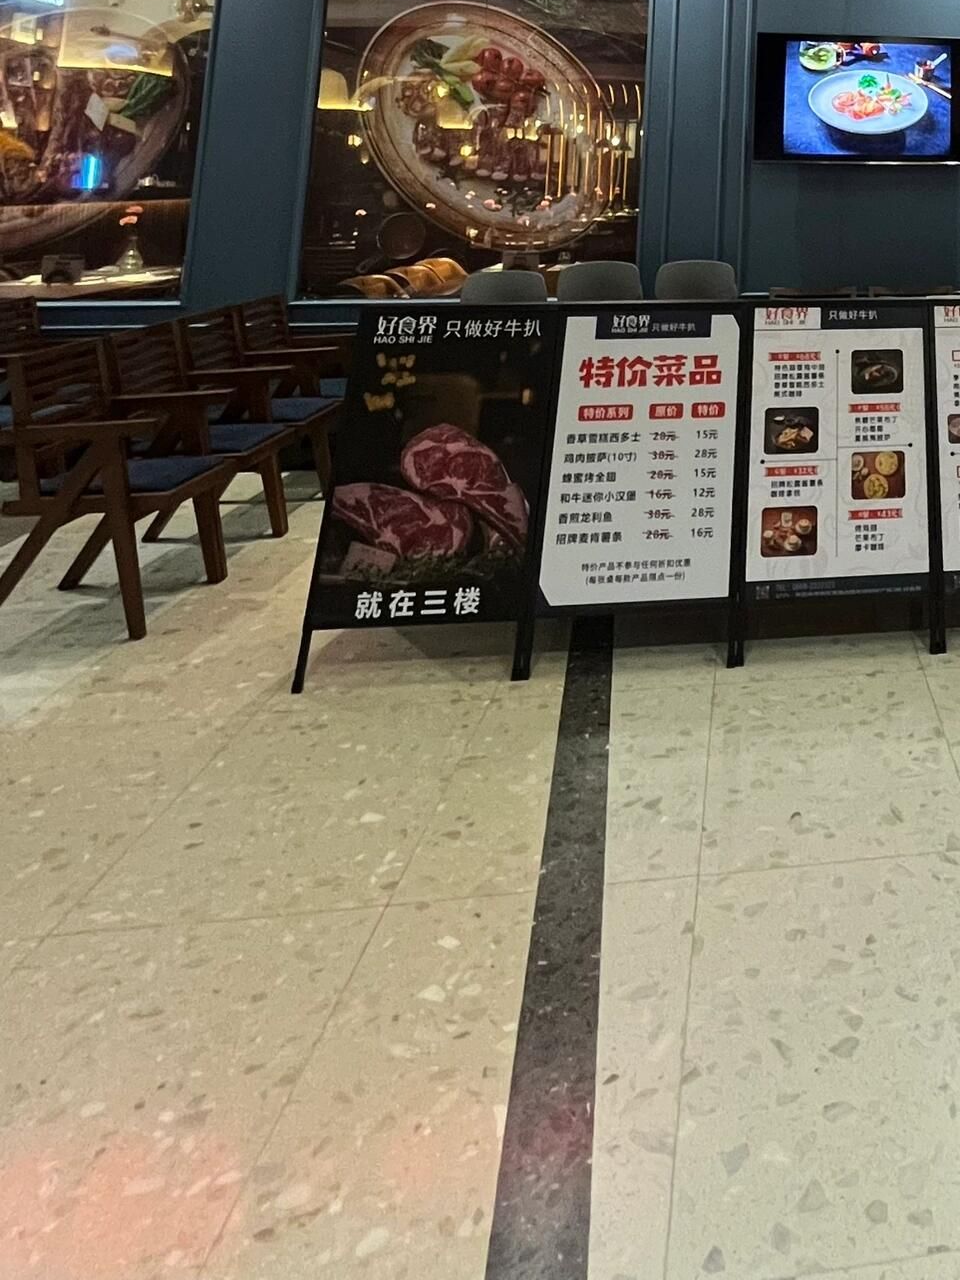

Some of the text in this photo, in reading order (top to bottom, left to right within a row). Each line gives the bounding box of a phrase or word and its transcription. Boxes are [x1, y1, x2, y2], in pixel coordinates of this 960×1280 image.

[612, 314, 650, 328] 好食界
[828, 310, 878, 320] 只做好牛扒
[376, 315, 438, 335] 好食界
[443, 319, 541, 338] 只做好牛扒
[651, 322, 697, 332] 只做好牛扒
[373, 335, 433, 344] HAO SHI JIE
[578, 354, 722, 388] 特价菜品
[583, 404, 720, 420] 特价系列 原价 特价
[696, 429, 719, 439] 15元
[694, 448, 718, 459] 28元
[694, 468, 717, 478] 15元
[560, 490, 636, 504] 和牛迷你小汉堡
[693, 487, 716, 498] 12元
[558, 511, 613, 524] 香煎龙利鱼
[691, 507, 715, 518] 28元
[691, 527, 714, 538] 16元
[354, 586, 481, 620] 就在三楼
